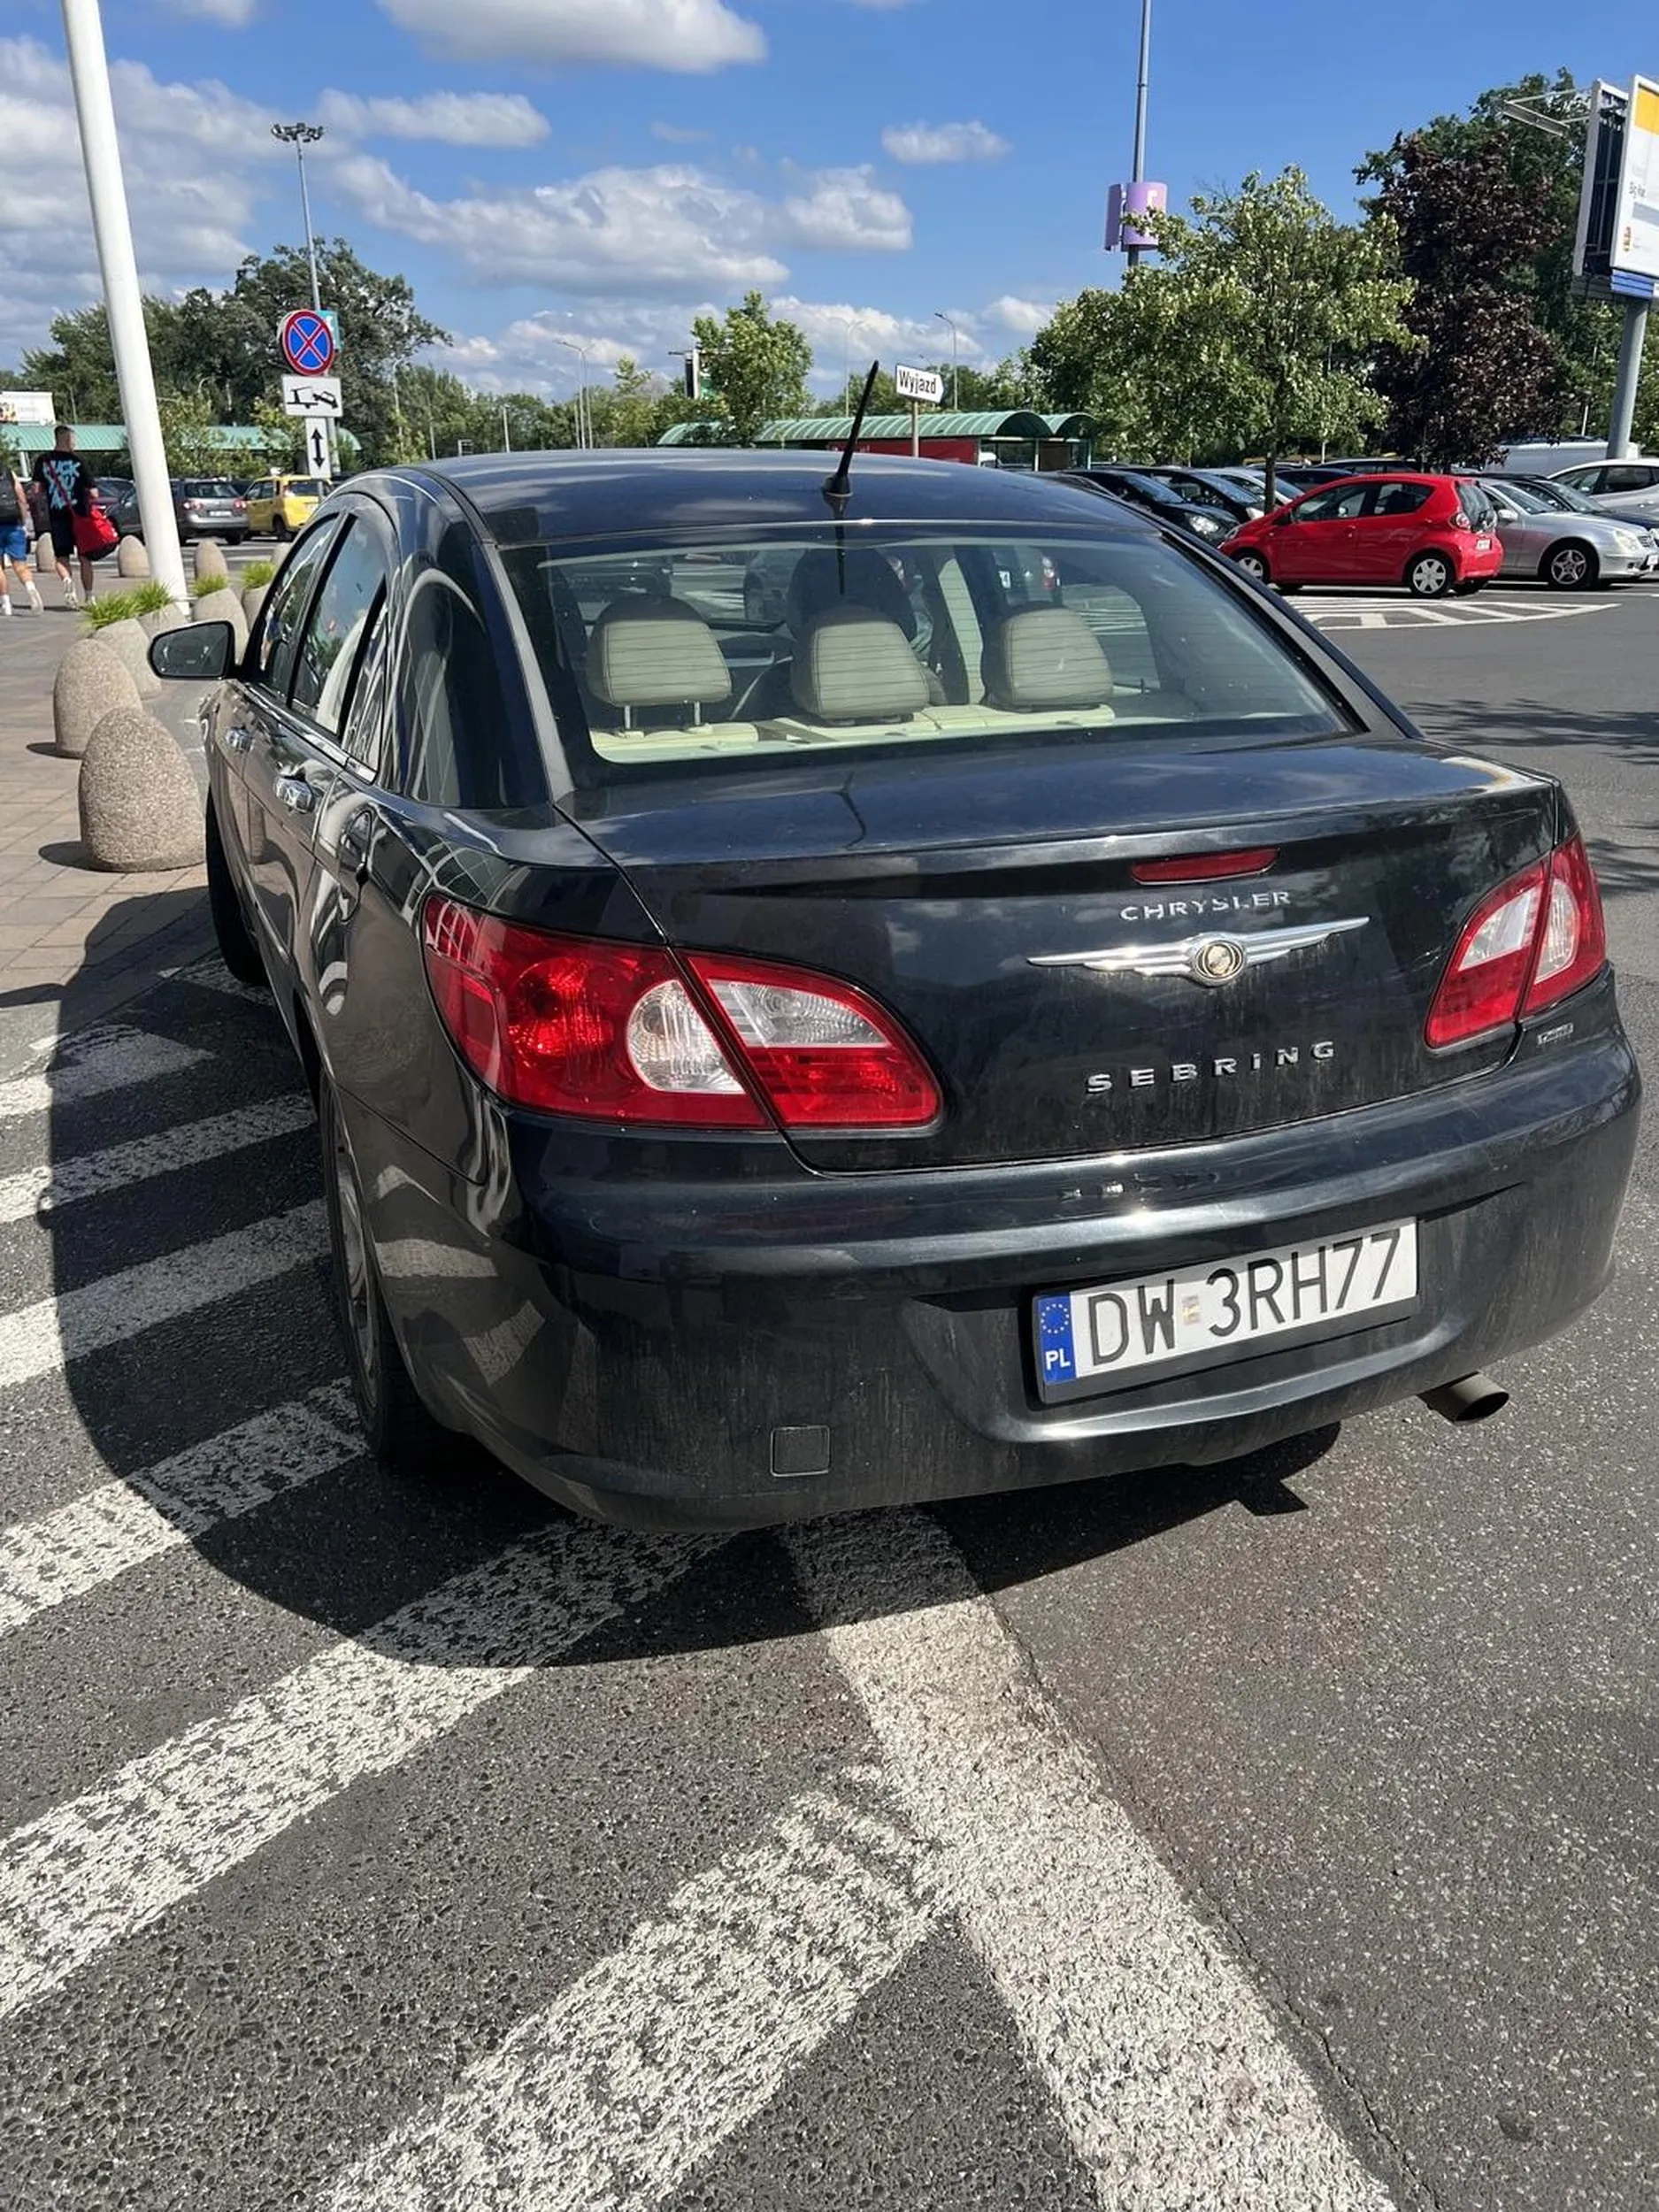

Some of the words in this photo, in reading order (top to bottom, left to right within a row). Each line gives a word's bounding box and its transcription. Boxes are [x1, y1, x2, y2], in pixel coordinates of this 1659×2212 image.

[899, 370, 937, 395] Wyjazd
[1120, 891, 1292, 921] CHRYSLER
[1087, 1041, 1334, 1093] SEBRING
[1087, 1279, 1176, 1366] DW
[1205, 1229, 1402, 1338] 3RH77
[1045, 1348, 1071, 1371] PL
